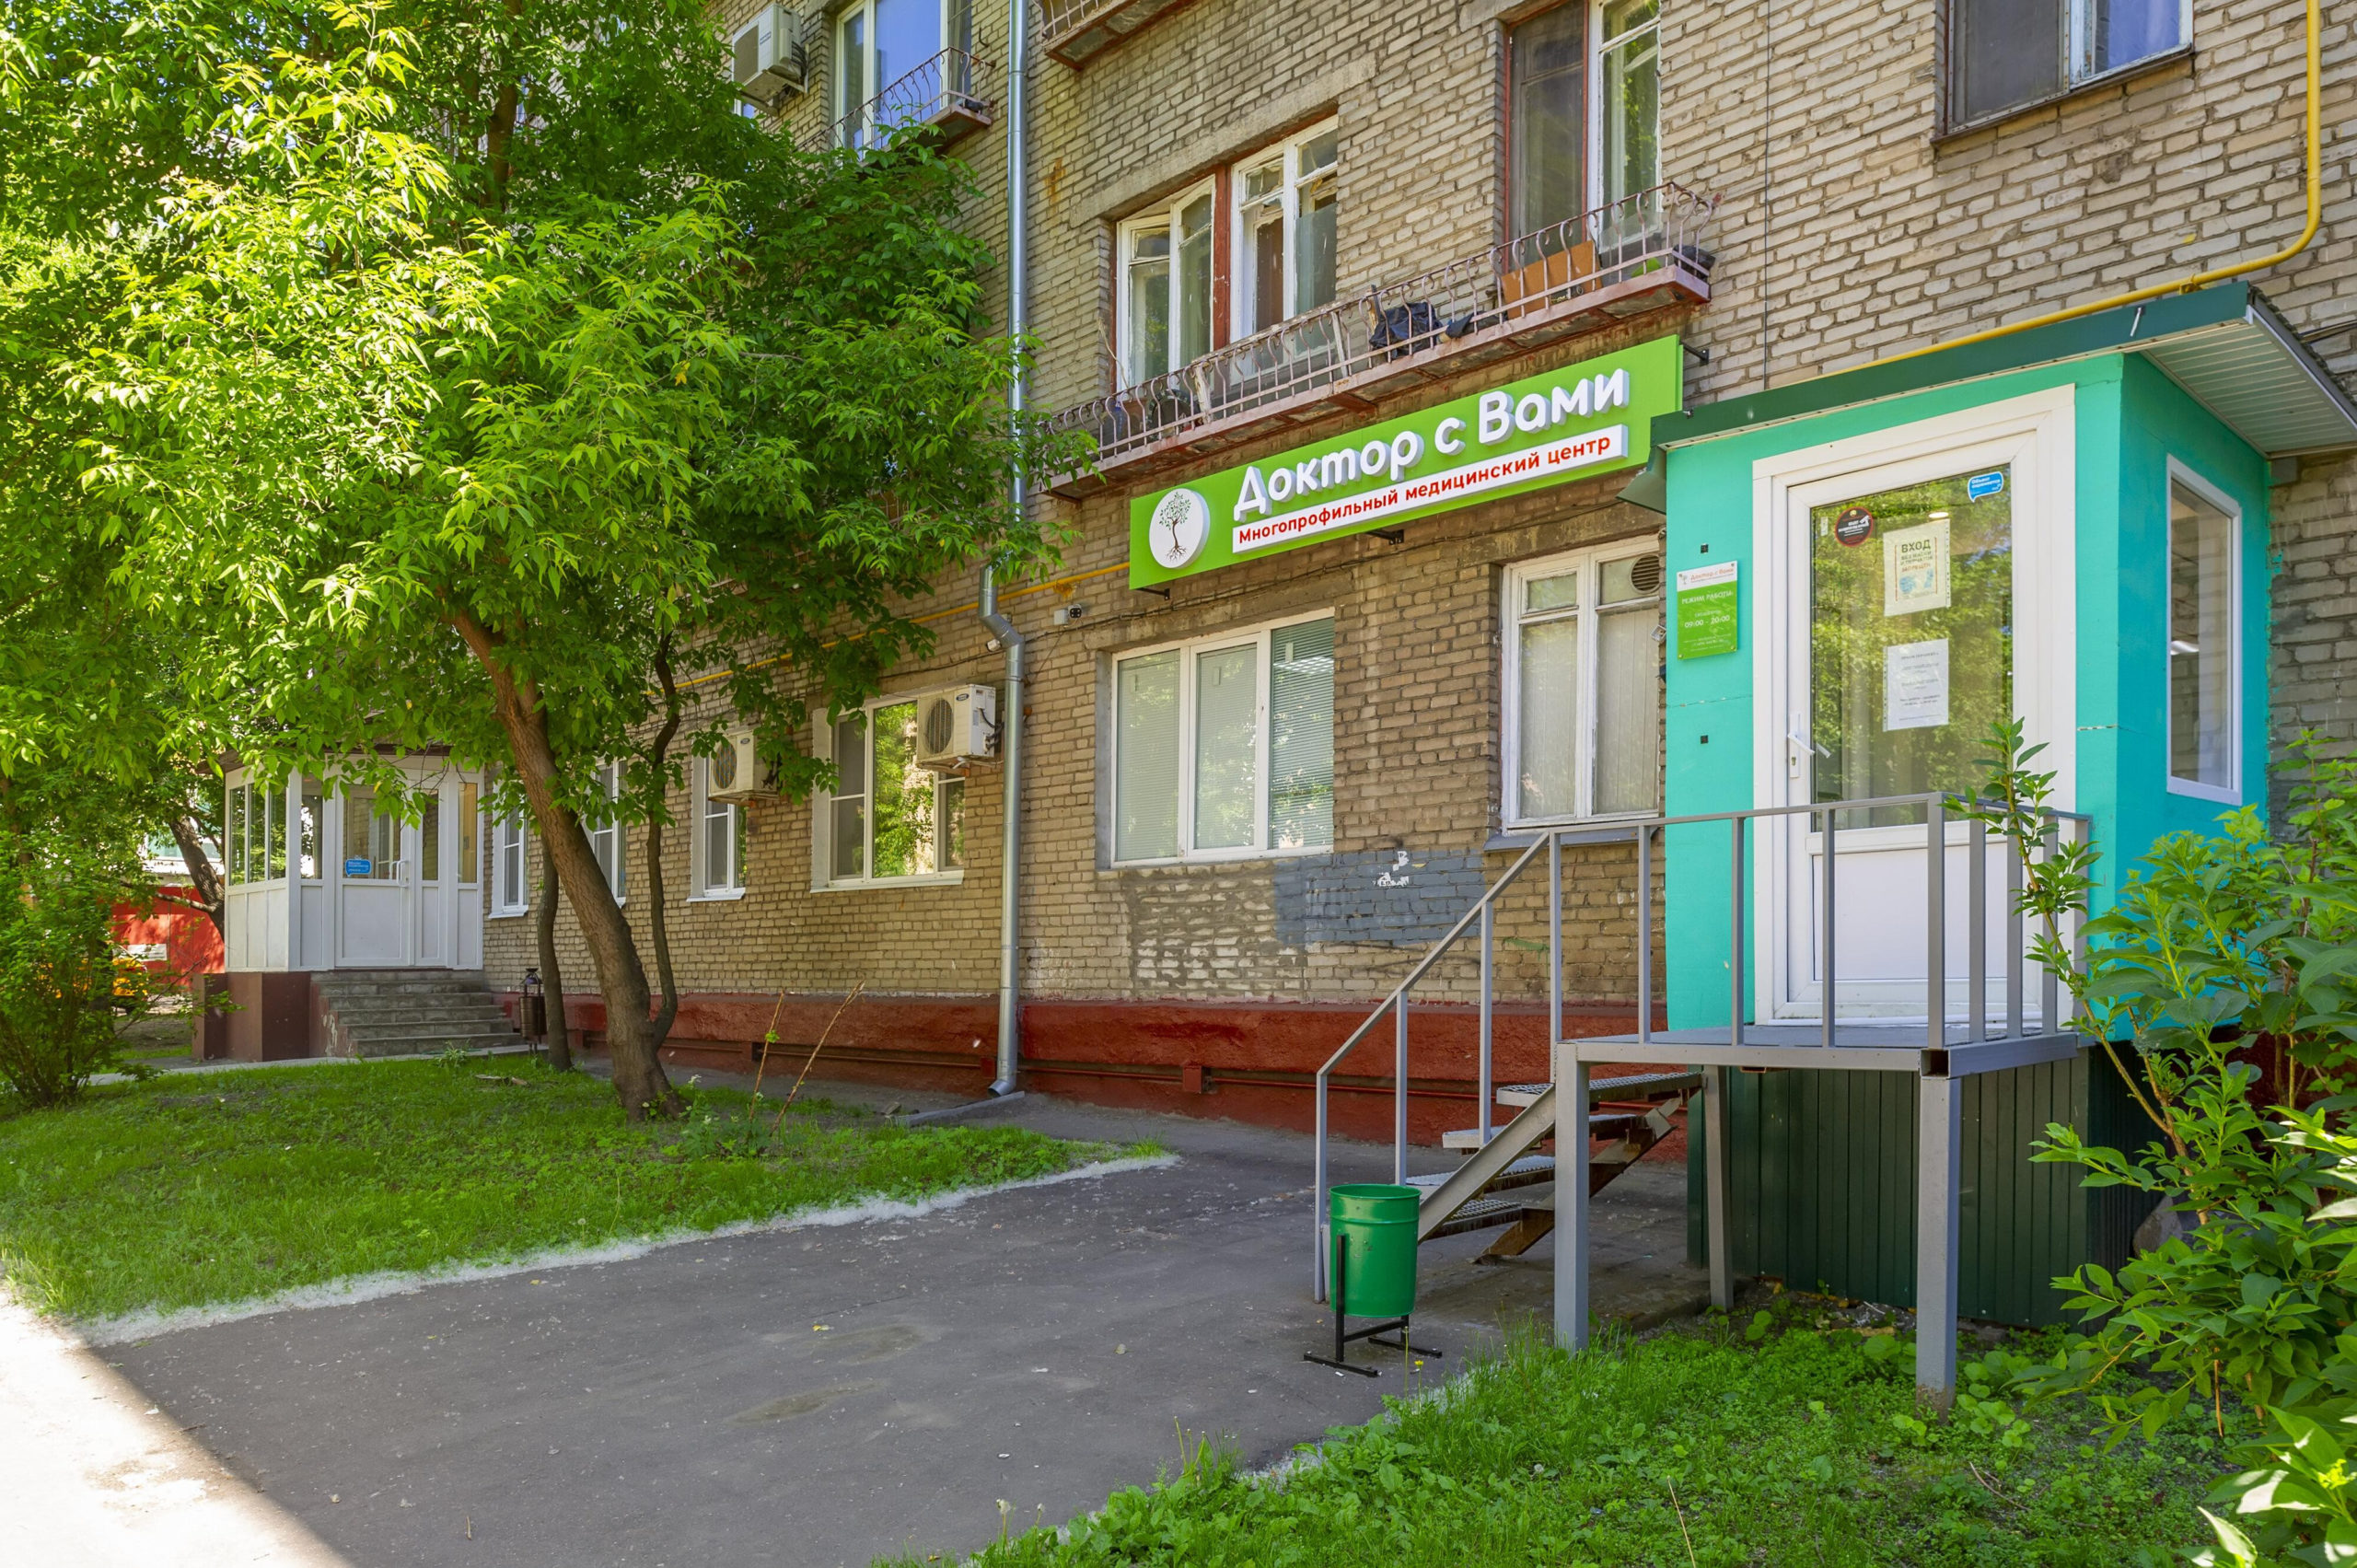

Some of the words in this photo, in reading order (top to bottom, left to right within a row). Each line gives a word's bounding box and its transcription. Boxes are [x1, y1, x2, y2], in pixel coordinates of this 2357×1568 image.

[1233, 430, 1424, 522] Доктор
[1434, 417, 1466, 456] с
[1479, 368, 1630, 446] Вами
[1238, 489, 1399, 544] Многопрофильный
[1405, 452, 1540, 501] медицинский
[1548, 436, 1611, 465] центр
[1901, 540, 1931, 553] ВХОД
[1681, 595, 1705, 605] РЕЖИМ
[1684, 619, 1704, 629] 09:00
[1711, 614, 1731, 625] 20:00
